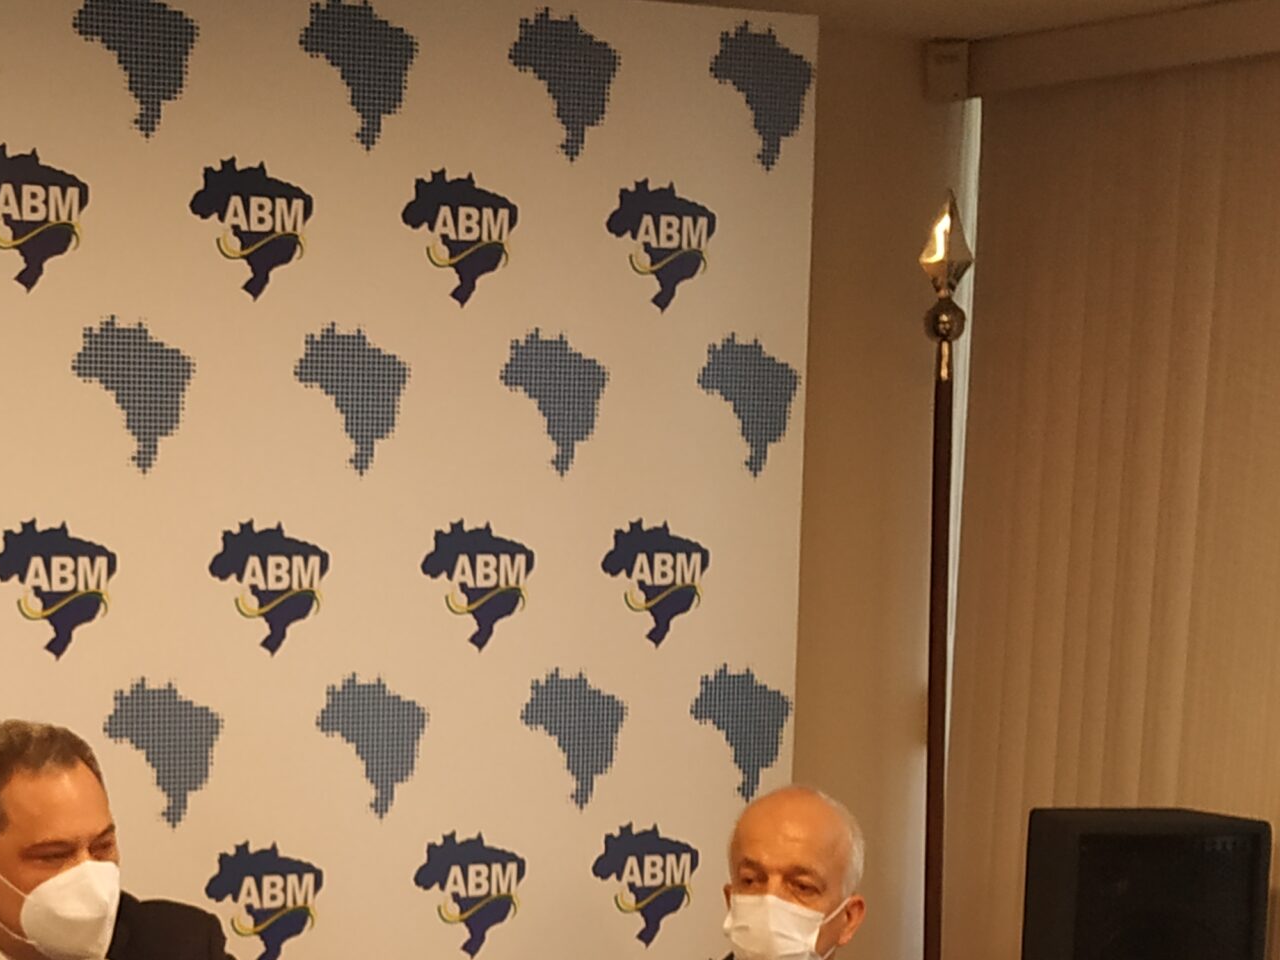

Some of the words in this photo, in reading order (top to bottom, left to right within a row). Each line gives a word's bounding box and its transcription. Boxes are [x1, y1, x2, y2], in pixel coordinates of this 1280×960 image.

[223, 196, 304, 234] ABM
[432, 206, 509, 243] ABM
[636, 215, 709, 249] ABM
[24, 556, 108, 592] ABM
[241, 556, 320, 591] ABM
[452, 555, 526, 588] ABM
[631, 553, 701, 586] ABM
[444, 863, 518, 897] ABM
[621, 854, 691, 888] ABM
[239, 874, 315, 908] ABM
